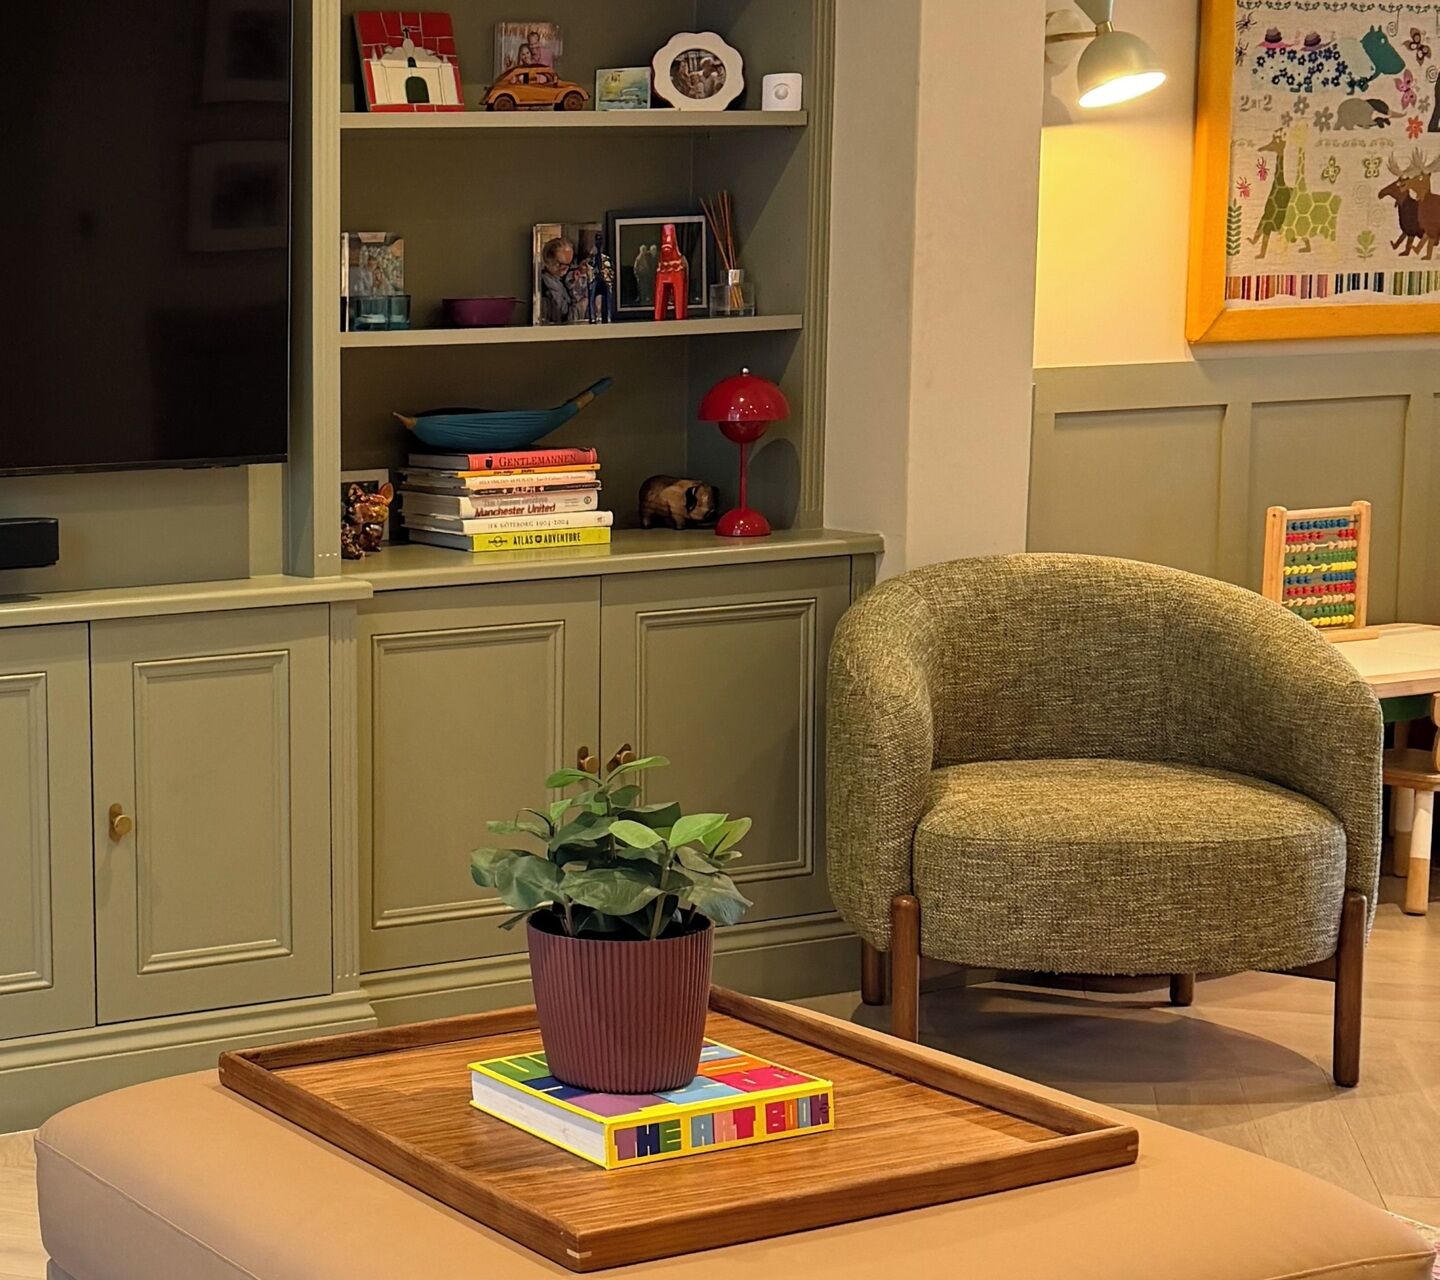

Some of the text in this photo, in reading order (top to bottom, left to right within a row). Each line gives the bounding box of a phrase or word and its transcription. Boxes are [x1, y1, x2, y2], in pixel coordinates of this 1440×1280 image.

[1240, 94, 1273, 111] 2 2
[499, 453, 576, 467] GENTLEMANNEN
[474, 503, 555, 517] Manchester United
[513, 535, 533, 545] ATLAS
[543, 532, 580, 542] ADVENTURE
[614, 1093, 831, 1161] THE ART BOOK
